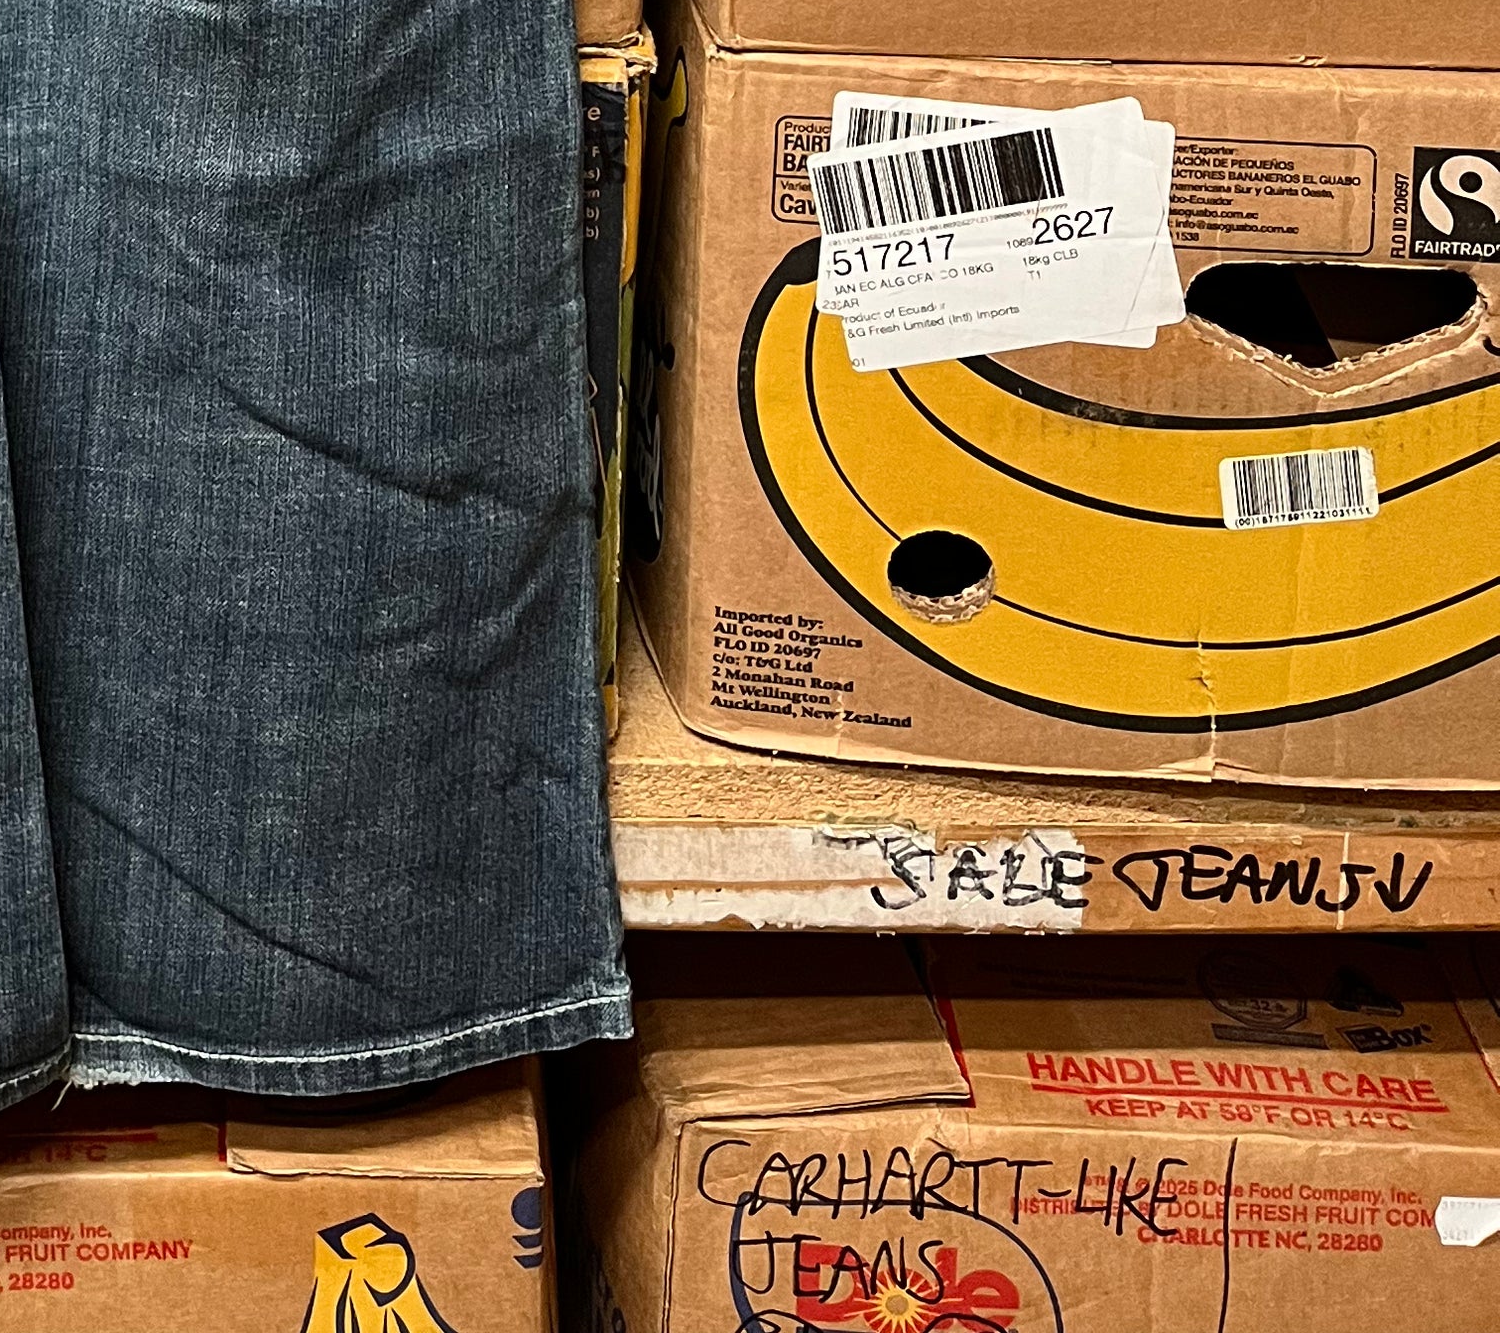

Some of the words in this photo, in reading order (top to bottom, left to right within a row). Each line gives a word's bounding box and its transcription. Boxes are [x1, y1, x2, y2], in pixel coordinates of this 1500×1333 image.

[832, 234, 955, 277] 517217
[1032, 206, 1114, 245] 2627
[859, 281, 877, 293] EC
[880, 276, 905, 289] ALG
[962, 262, 994, 277] 18KG
[714, 606, 793, 626] Imported
[713, 622, 738, 636] All
[741, 625, 785, 640] Good
[713, 636, 747, 651] FLO
[750, 641, 770, 653] ID
[774, 643, 821, 660] 20697
[784, 660, 813, 673] Ltd
[711, 680, 735, 694] Mt
[738, 683, 831, 705] Wellington
[724, 668, 806, 688] Monahan
[810, 677, 854, 693] Road
[710, 695, 798, 719] Auckland,
[1026, 1051, 1200, 1087] HANDLE
[1204, 1060, 1315, 1094] WITH
[1322, 1070, 1440, 1105] CARE
[1085, 1098, 1165, 1119] KEEP
[1176, 1101, 1208, 1120] AT
[1289, 1107, 1336, 1129] OR
[1249, 1182, 1294, 1199] Food
[1300, 1184, 1386, 1205] Company,
[1235, 1201, 1308, 1224] FRESH
[1315, 1204, 1380, 1226] FRUIT
[79, 1222, 113, 1239] Inc.
[1275, 1231, 1312, 1251] NC,
[1317, 1233, 1383, 1252] 28280
[5, 1243, 71, 1262] FRUIT
[75, 1239, 194, 1261] COMPANY
[734, 1231, 944, 1304] JEANS
[8, 1271, 76, 1291] 28280
